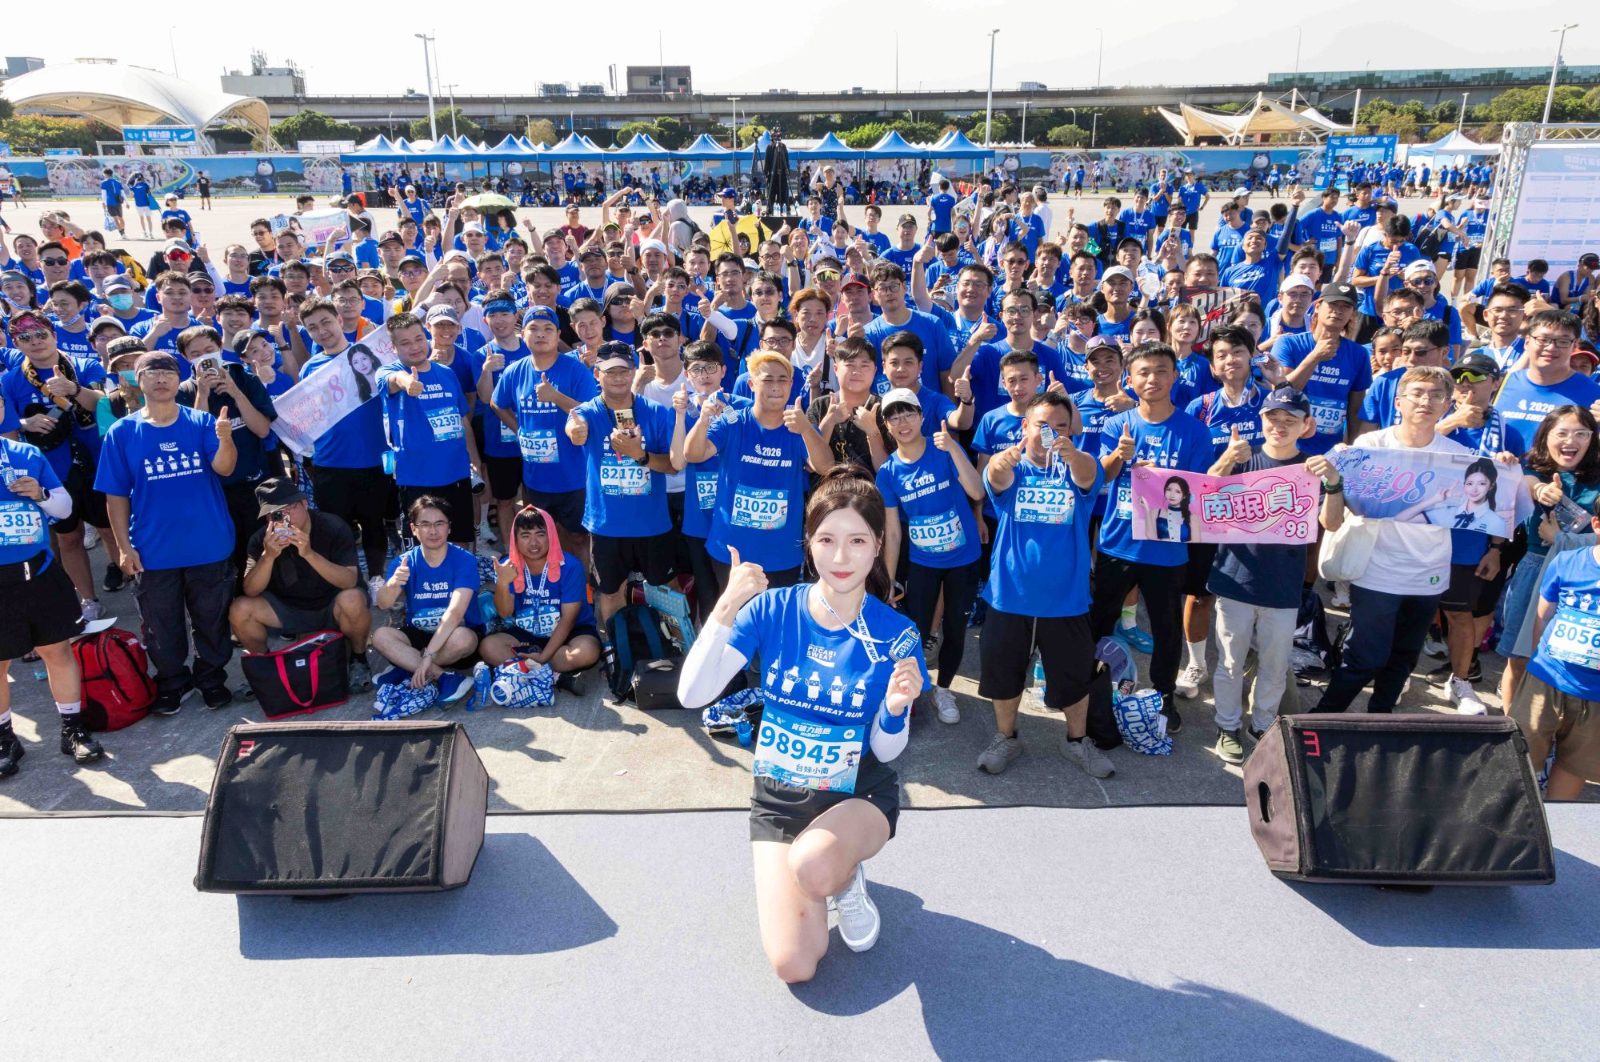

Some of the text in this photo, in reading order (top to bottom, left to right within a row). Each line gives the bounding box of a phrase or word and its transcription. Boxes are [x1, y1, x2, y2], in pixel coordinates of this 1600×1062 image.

[1321, 366, 1340, 376] 2026
[1530, 402, 1555, 412] 2026
[430, 415, 460, 428] 82397
[762, 447, 781, 457] 2026
[741, 455, 762, 464] POCARI
[602, 468, 643, 480] 82179
[914, 474, 935, 488] 2026
[1381, 471, 1435, 503] 98
[698, 483, 717, 494] 82
[918, 485, 936, 498] SWEAT
[938, 480, 950, 490] RUN
[1017, 489, 1065, 505] 82322
[1202, 484, 1296, 521] 南珉貞
[735, 497, 778, 514] 81020
[0, 514, 33, 527] 381
[910, 523, 954, 539] 81021
[1285, 521, 1308, 538] 98
[432, 582, 448, 590] 2026
[414, 618, 441, 627] 825
[518, 615, 553, 630] 8253
[808, 645, 836, 657] POCARI
[808, 651, 833, 661] SWEAT
[778, 697, 811, 709] POCARI
[813, 705, 844, 717] SWEAT
[759, 726, 841, 764] 98945
